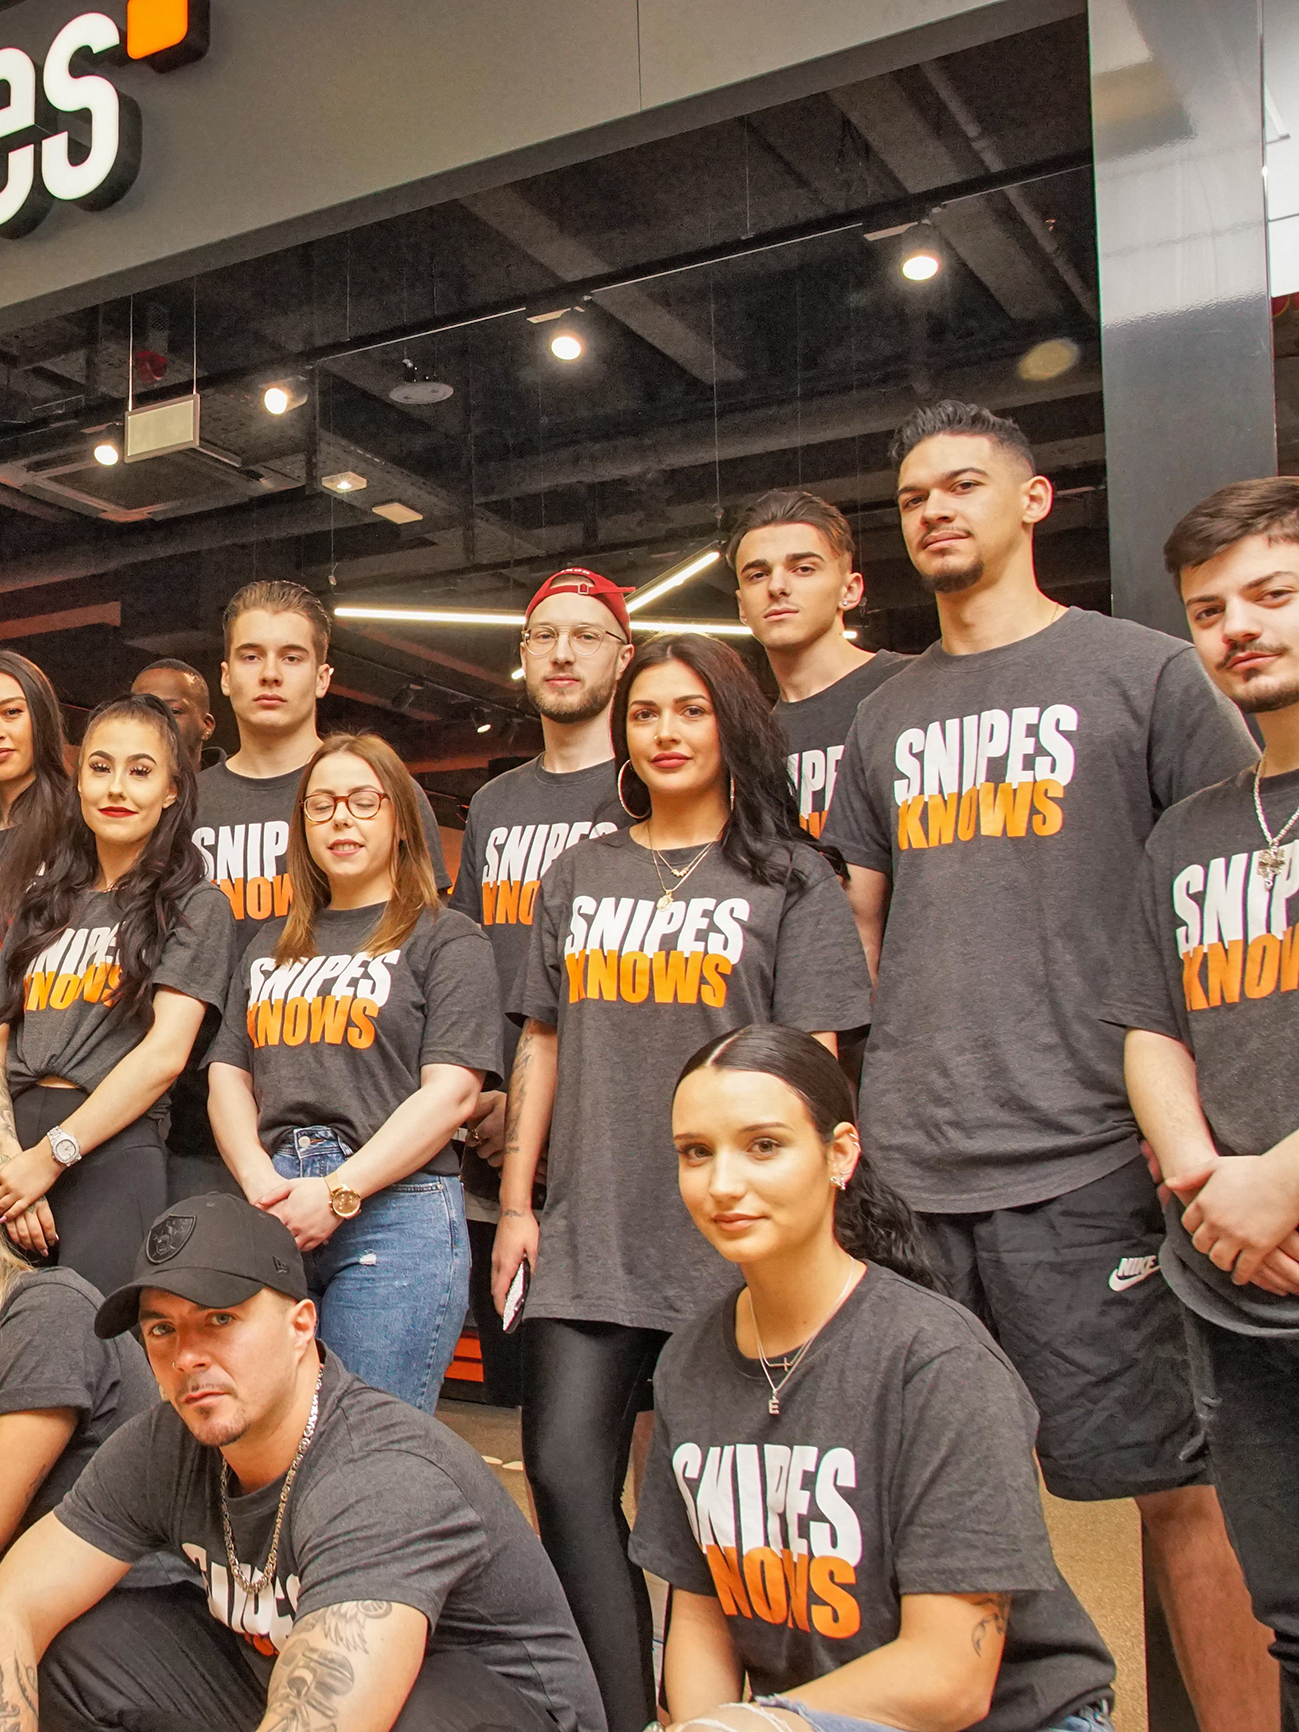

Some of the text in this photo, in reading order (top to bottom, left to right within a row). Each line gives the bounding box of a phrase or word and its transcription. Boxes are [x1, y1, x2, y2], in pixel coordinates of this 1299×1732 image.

[894, 704, 1078, 807] SNIPES
[898, 778, 1065, 851] KNOWS
[563, 895, 751, 965] SNIPES
[247, 949, 401, 1012] SNIPES
[565, 948, 733, 1008] KNOWS
[672, 1442, 863, 1568] SNIPES
